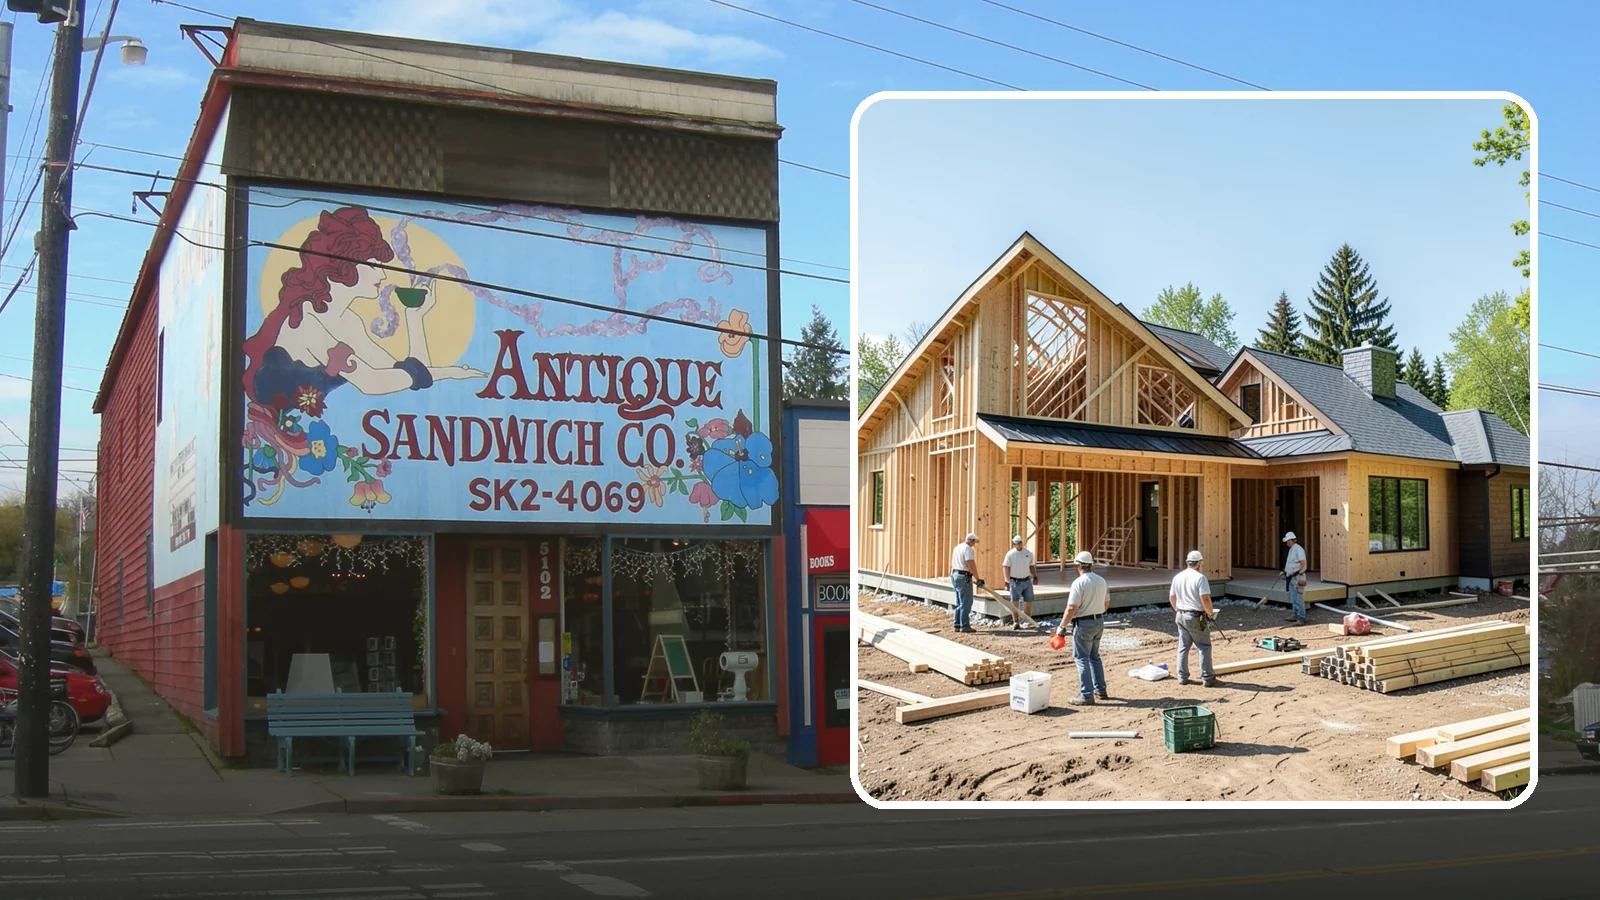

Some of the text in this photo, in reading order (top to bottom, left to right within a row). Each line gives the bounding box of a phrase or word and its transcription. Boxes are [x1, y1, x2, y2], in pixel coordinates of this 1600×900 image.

[475, 329, 723, 420] ANTIQUE
[361, 409, 685, 469] SANDWICH CO.
[468, 477, 646, 513] SK2-4069
[540, 541, 551, 600] 5102
[809, 555, 834, 569] BOOKS
